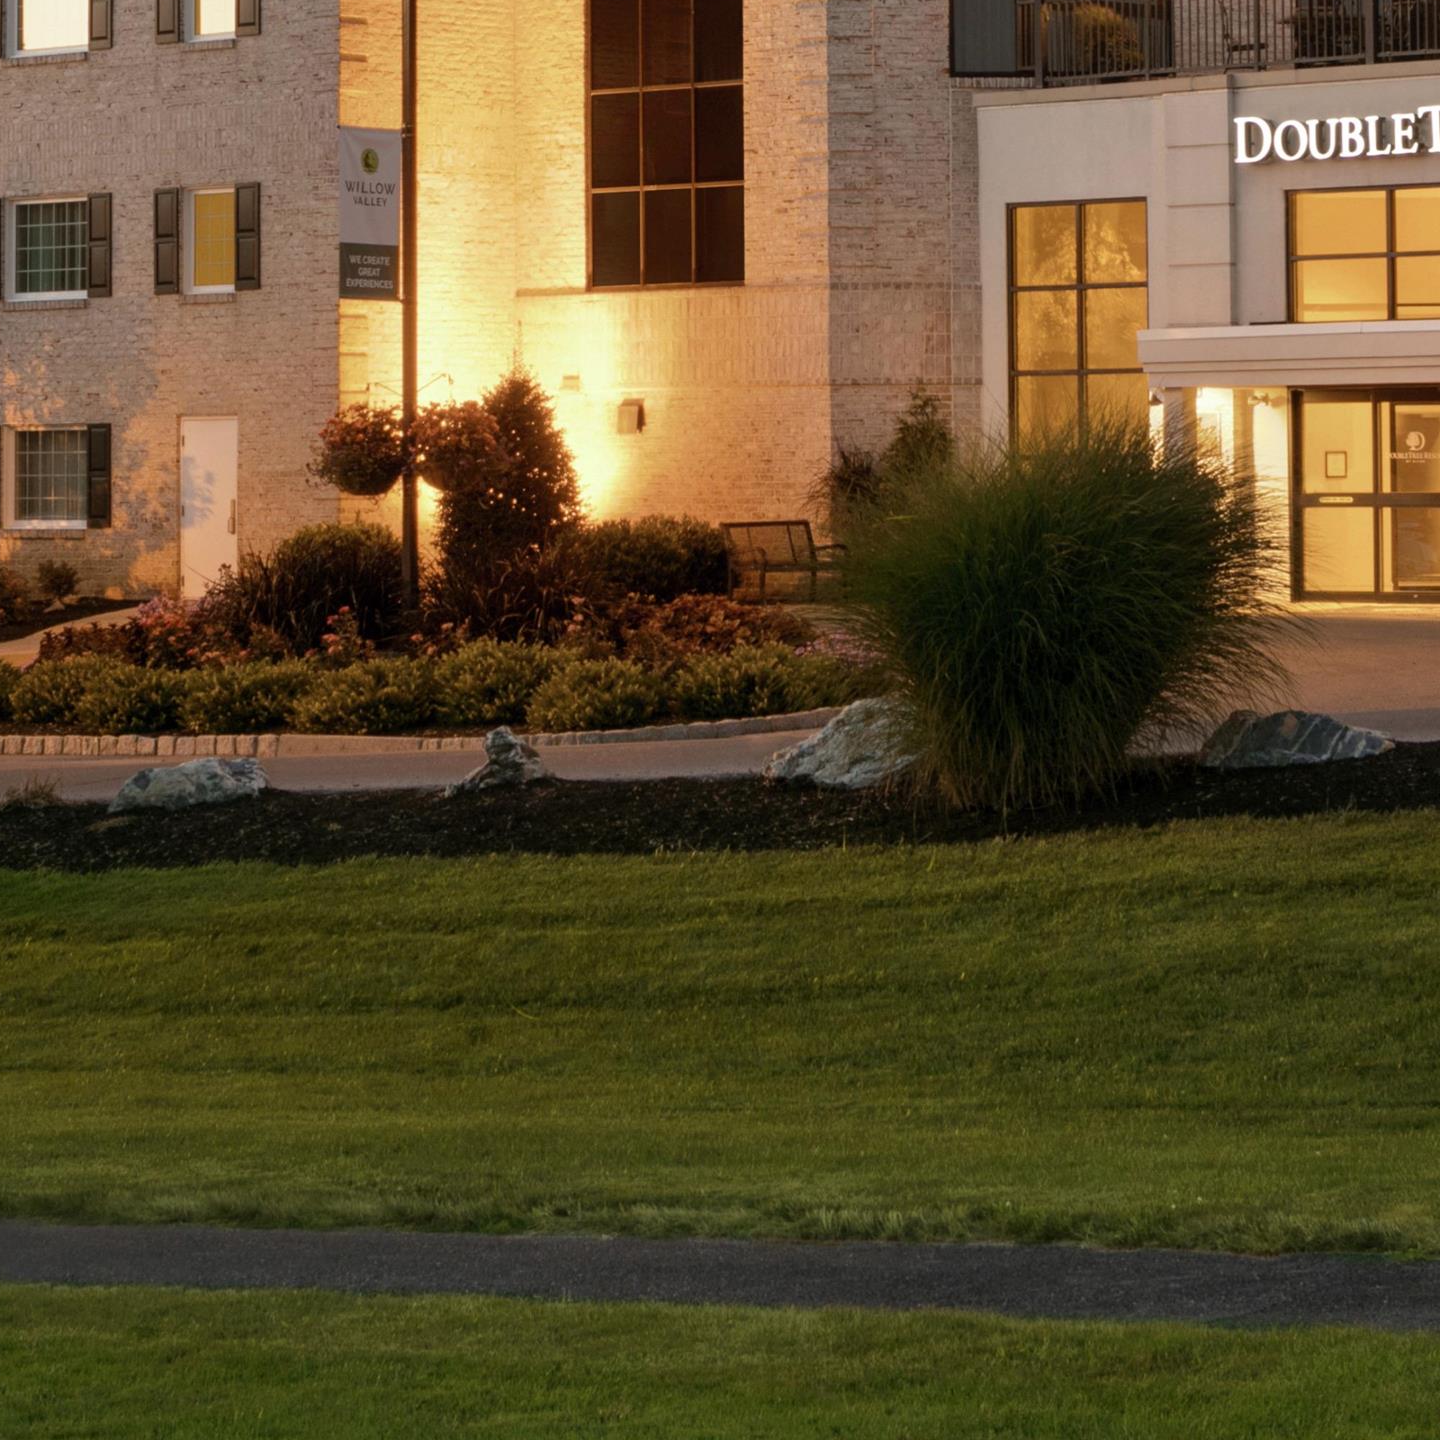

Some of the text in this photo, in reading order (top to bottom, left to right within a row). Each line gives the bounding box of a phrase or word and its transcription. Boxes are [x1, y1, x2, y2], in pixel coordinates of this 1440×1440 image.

[344, 180, 396, 195] WILLOW
[352, 196, 388, 207] VALLEY
[349, 255, 390, 266] WE CREATE
[358, 267, 381, 277] GREAT
[346, 279, 393, 289] EXPERIENCES
